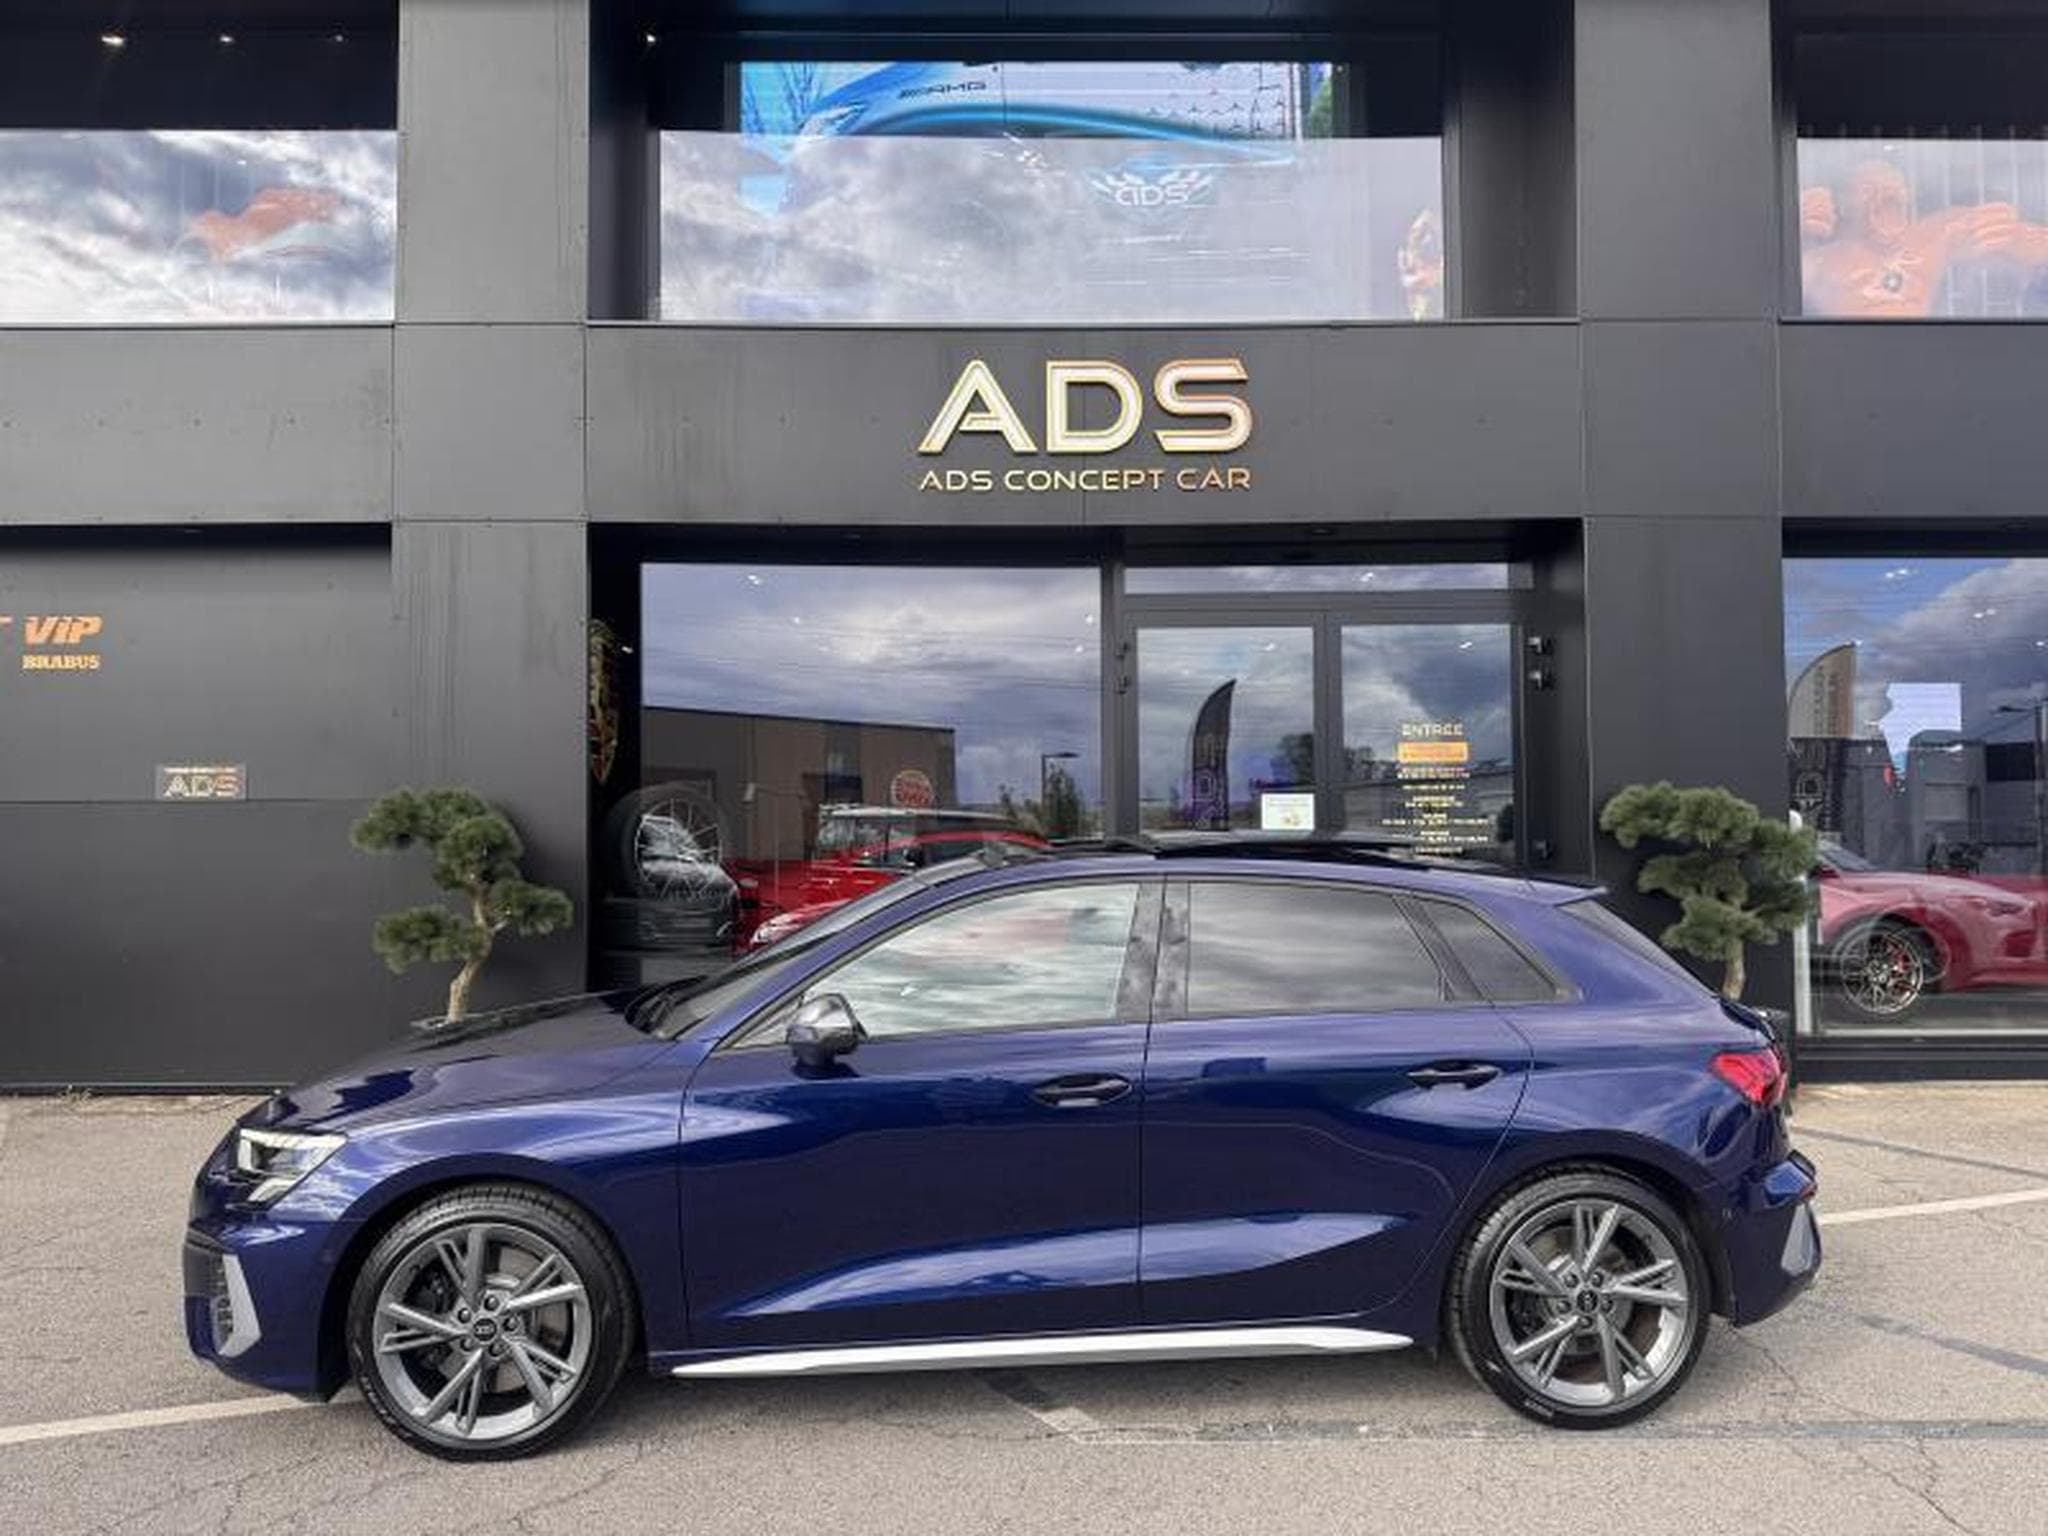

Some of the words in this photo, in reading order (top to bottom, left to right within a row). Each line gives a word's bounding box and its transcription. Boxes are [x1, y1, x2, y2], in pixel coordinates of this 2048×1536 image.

[917, 358, 1253, 454] ADS
[919, 469, 994, 492] ADS
[1004, 469, 1165, 492] CONCEPT
[1176, 467, 1251, 491] CAR
[22, 655, 101, 670] BRABUS
[163, 775, 239, 797] ADS
